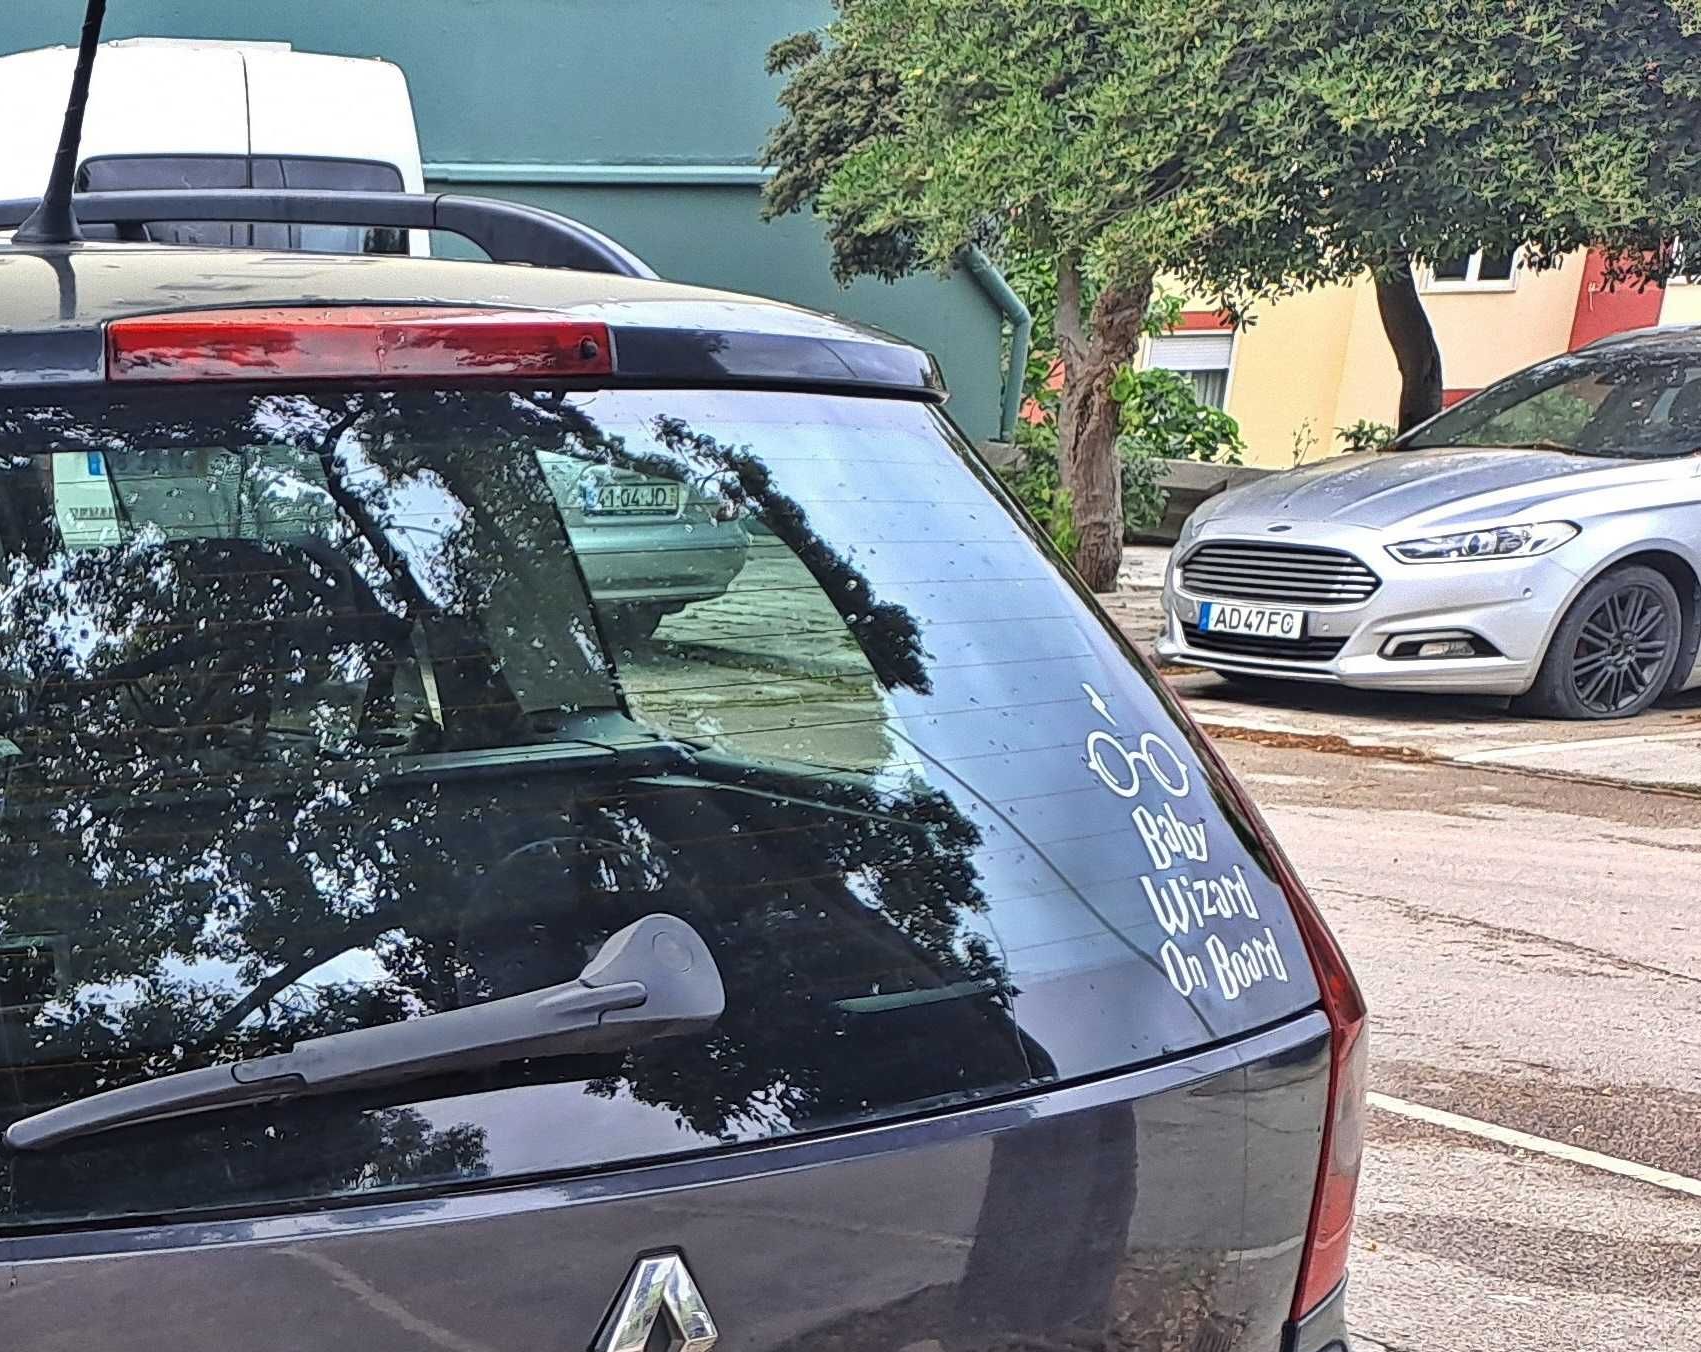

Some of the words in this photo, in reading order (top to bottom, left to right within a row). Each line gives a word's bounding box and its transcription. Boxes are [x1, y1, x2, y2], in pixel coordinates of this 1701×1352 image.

[1132, 803, 1209, 870] Baby
[1140, 865, 1259, 936] Wizard
[1161, 939, 1208, 997] On
[1205, 927, 1288, 1001] Board
